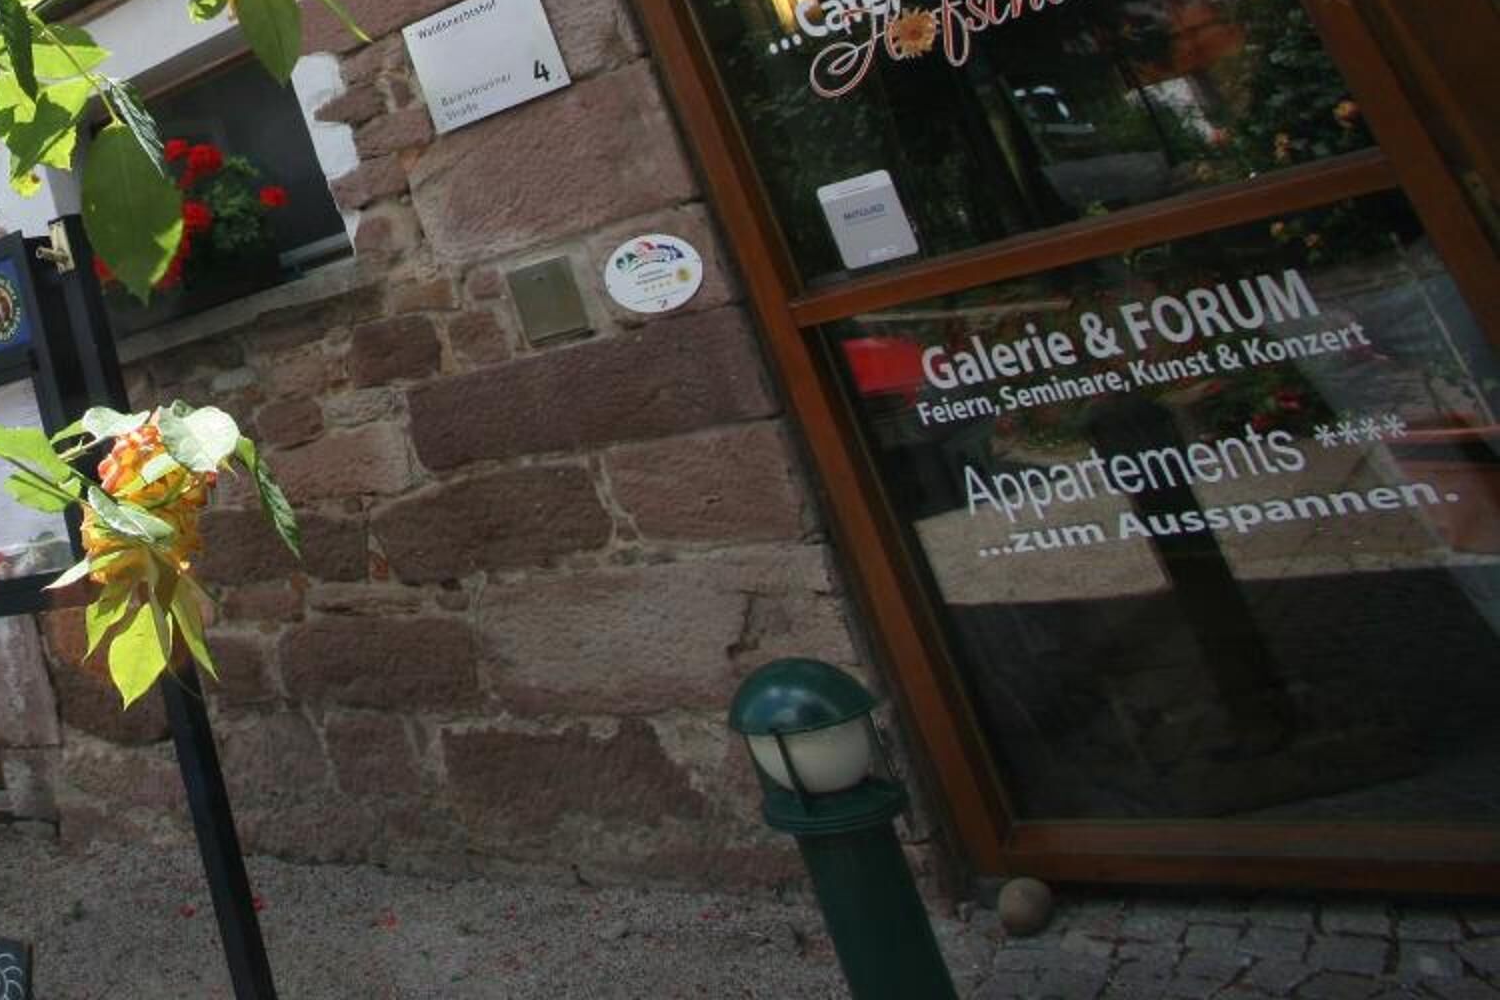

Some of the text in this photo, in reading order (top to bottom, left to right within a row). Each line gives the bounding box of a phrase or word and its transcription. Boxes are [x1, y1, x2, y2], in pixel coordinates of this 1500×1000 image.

[533, 60, 551, 83] 4
[916, 321, 1370, 427] Feiern, Seminare, Kunst & Konzert
[921, 268, 1318, 390] Galerie & FORUM
[963, 420, 1305, 524] Appartements
[1118, 481, 1462, 541] Ausspannen.
